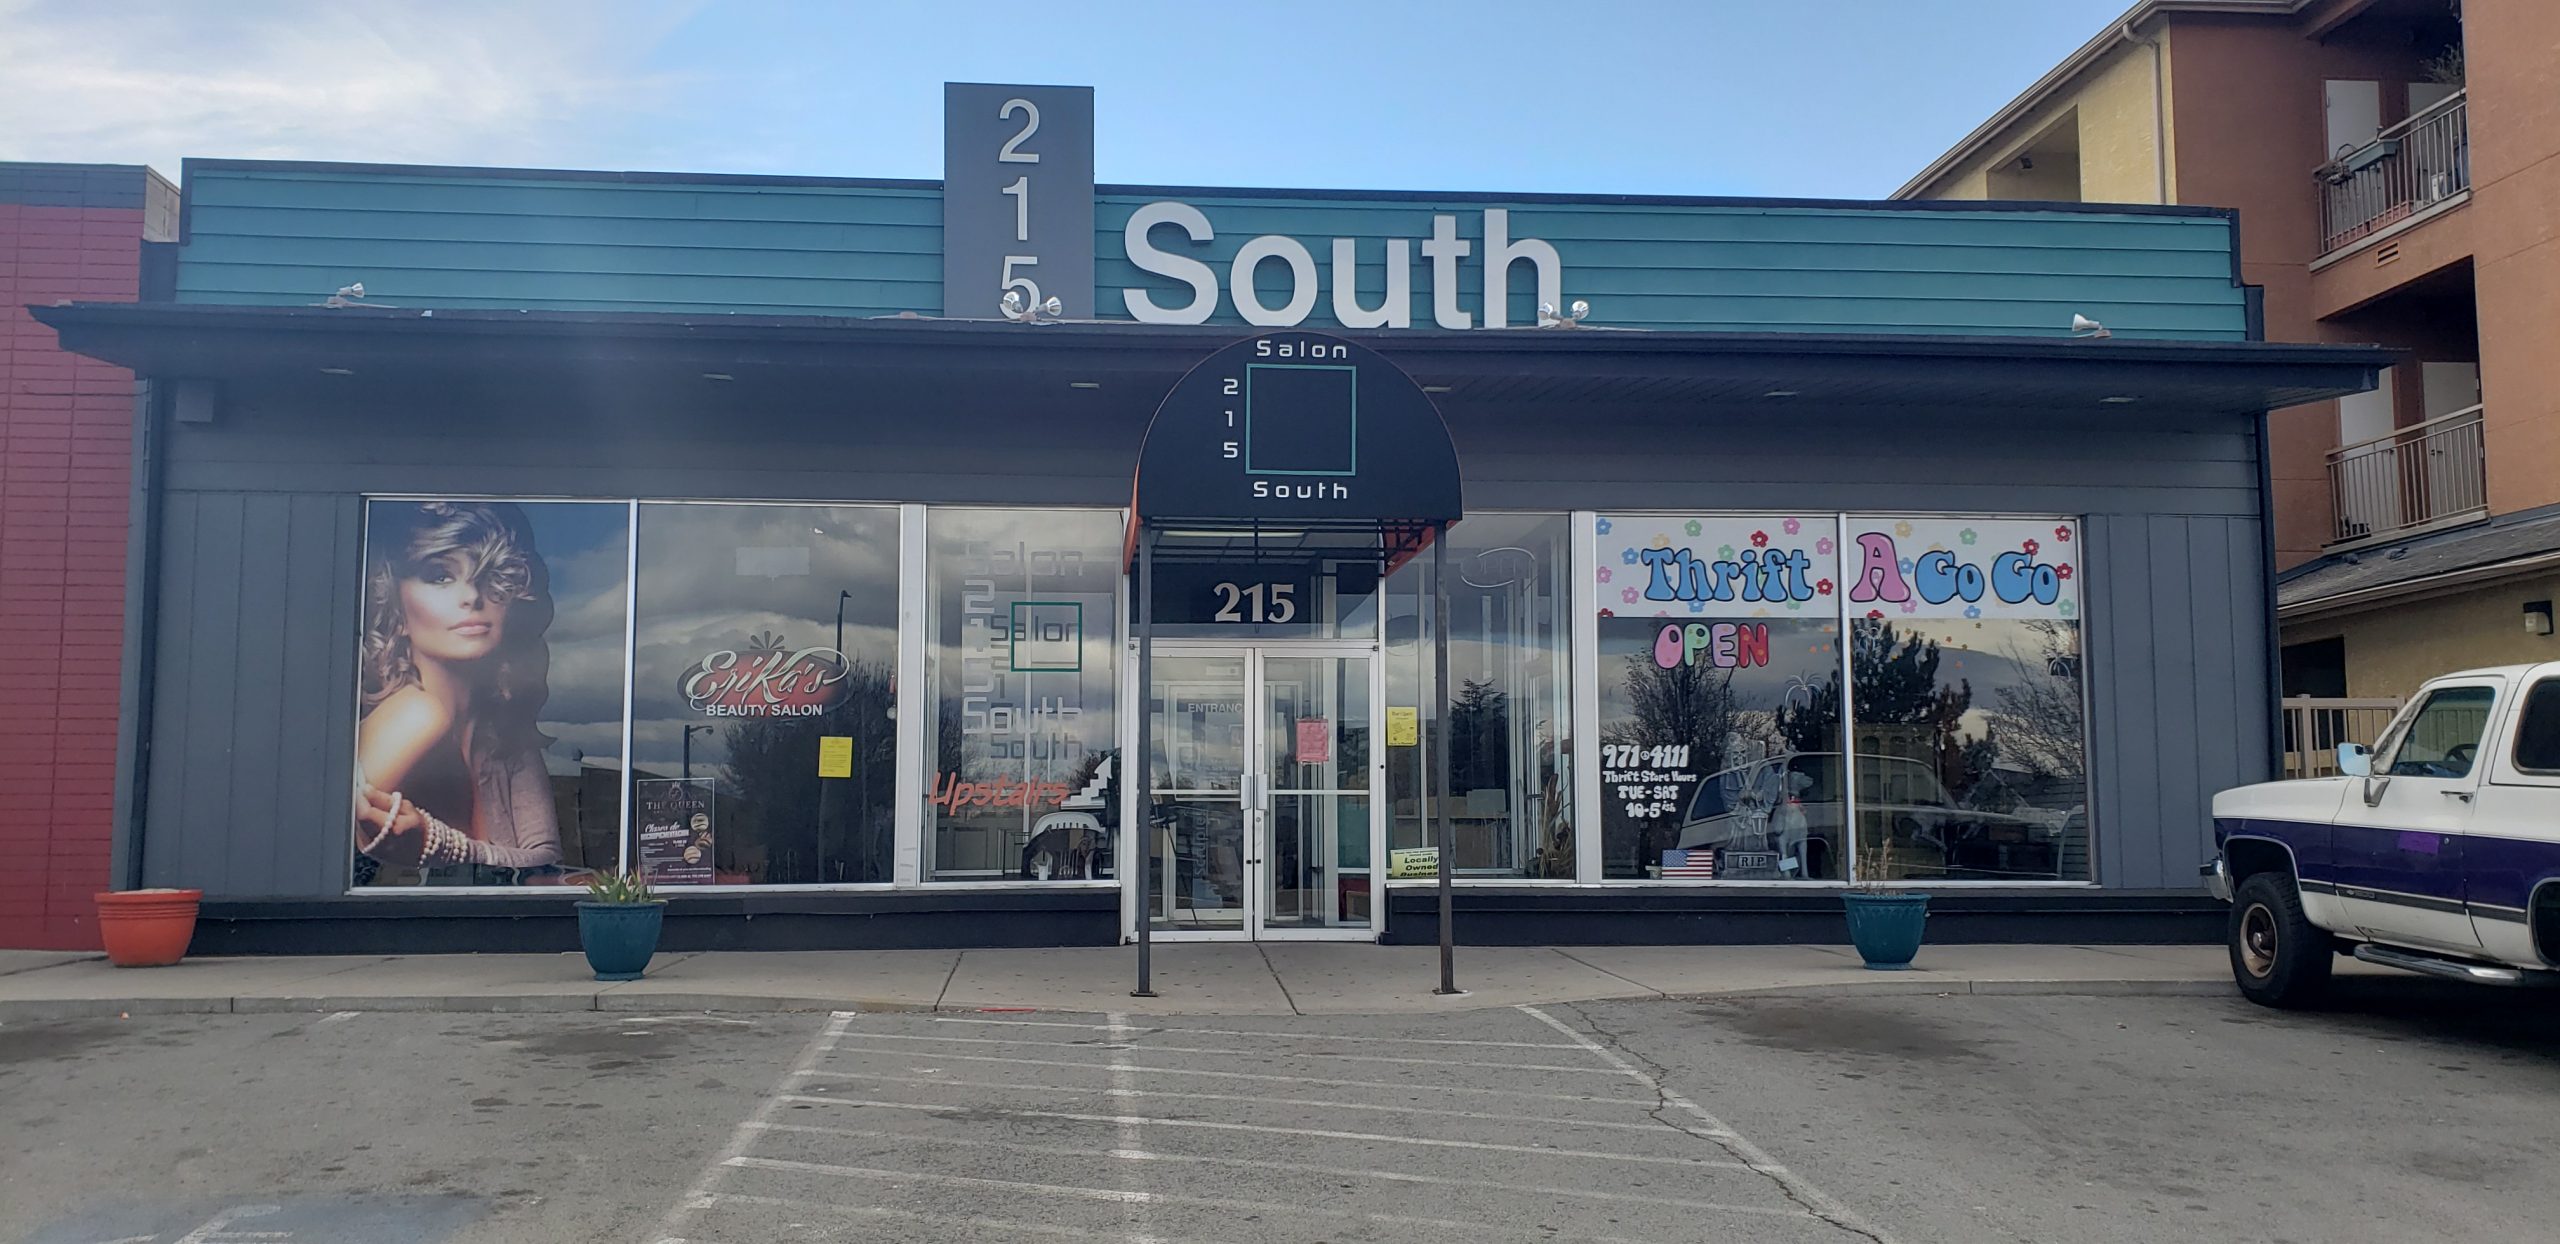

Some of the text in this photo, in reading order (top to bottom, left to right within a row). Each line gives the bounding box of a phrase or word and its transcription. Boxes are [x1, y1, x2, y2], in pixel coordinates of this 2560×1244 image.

[1122, 200, 1561, 330] South
[1256, 339, 1348, 359] Salon
[1253, 480, 1349, 500] South
[1641, 547, 1815, 603] Thrift
[1849, 531, 2061, 606] A Go Go
[1213, 582, 1296, 623] 215
[1653, 622, 1770, 670] OPEN
[705, 703, 823, 718] BEAUTY SALON
[962, 696, 1083, 735] South
[1187, 702, 1243, 713] ENTRANC
[1602, 770, 1640, 783] Thrift
[1641, 770, 1670, 783] Store
[927, 770, 1071, 816] Upstairs
[670, 800, 705, 810] QUEEN
[1404, 856, 1438, 864] Locally
[1405, 863, 1438, 871] Owned
[1741, 856, 1765, 867] RIP
